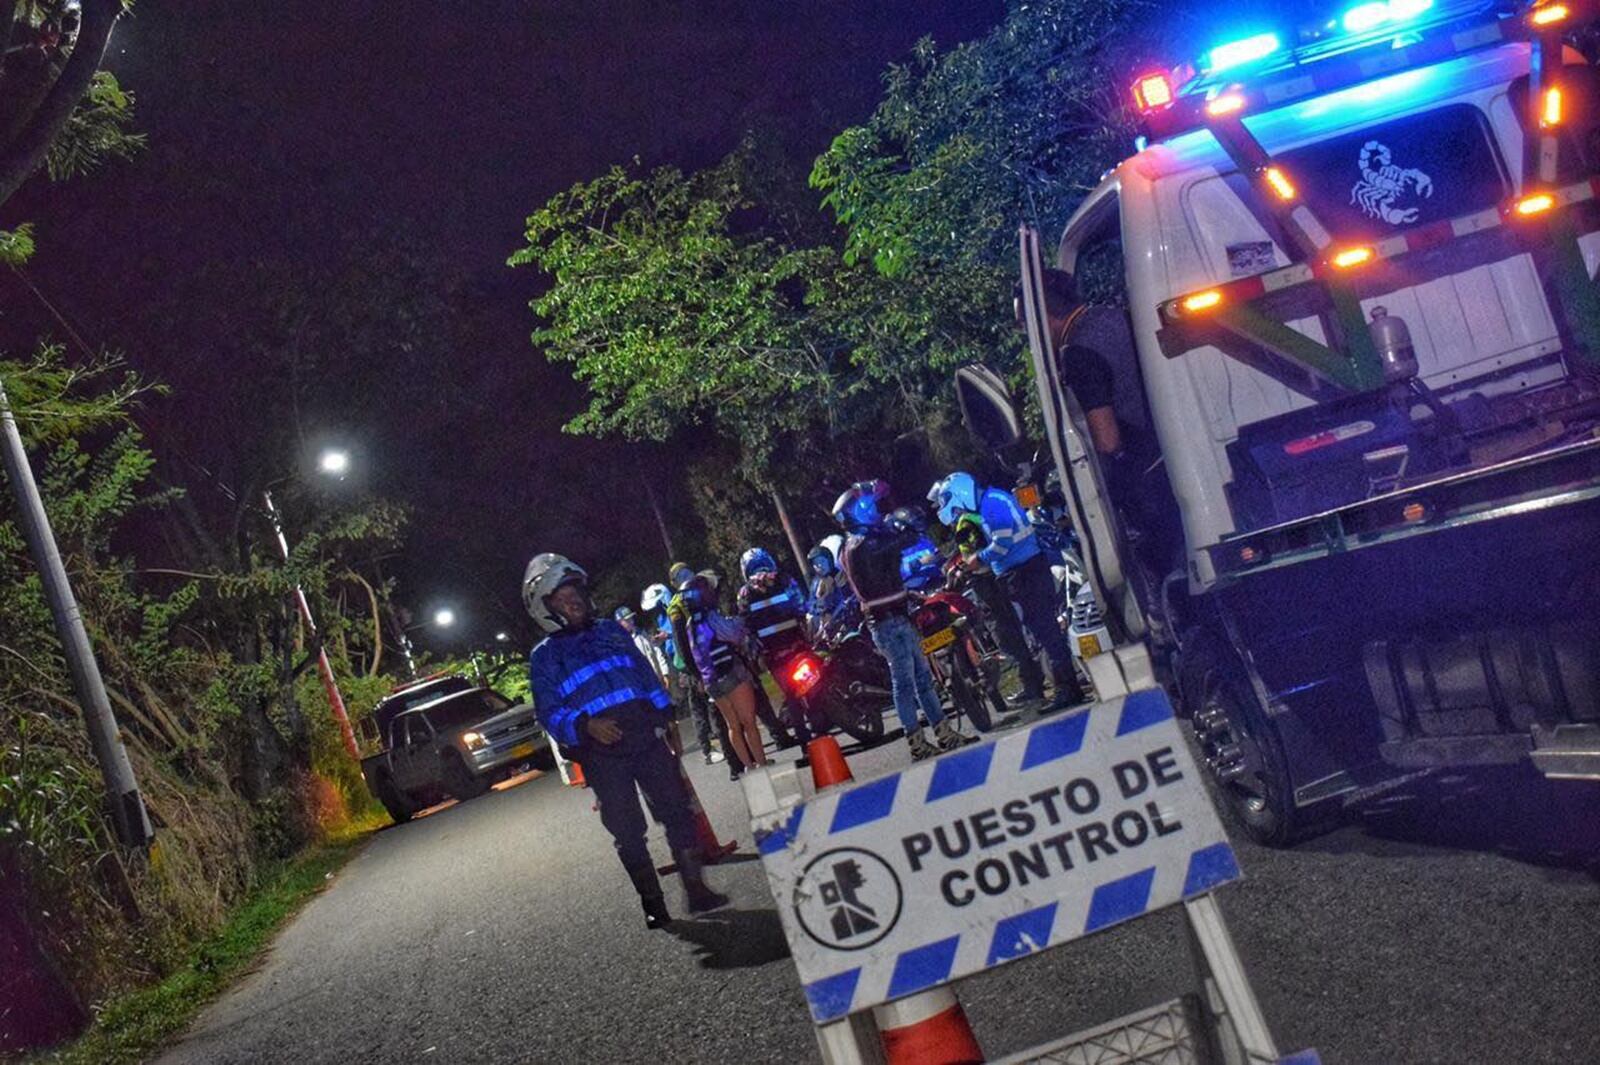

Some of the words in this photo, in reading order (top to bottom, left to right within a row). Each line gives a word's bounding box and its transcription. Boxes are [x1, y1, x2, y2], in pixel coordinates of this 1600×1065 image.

[902, 778, 1101, 872] PUESTO
[1112, 746, 1184, 798] DE
[940, 801, 1183, 907] CONTROL
